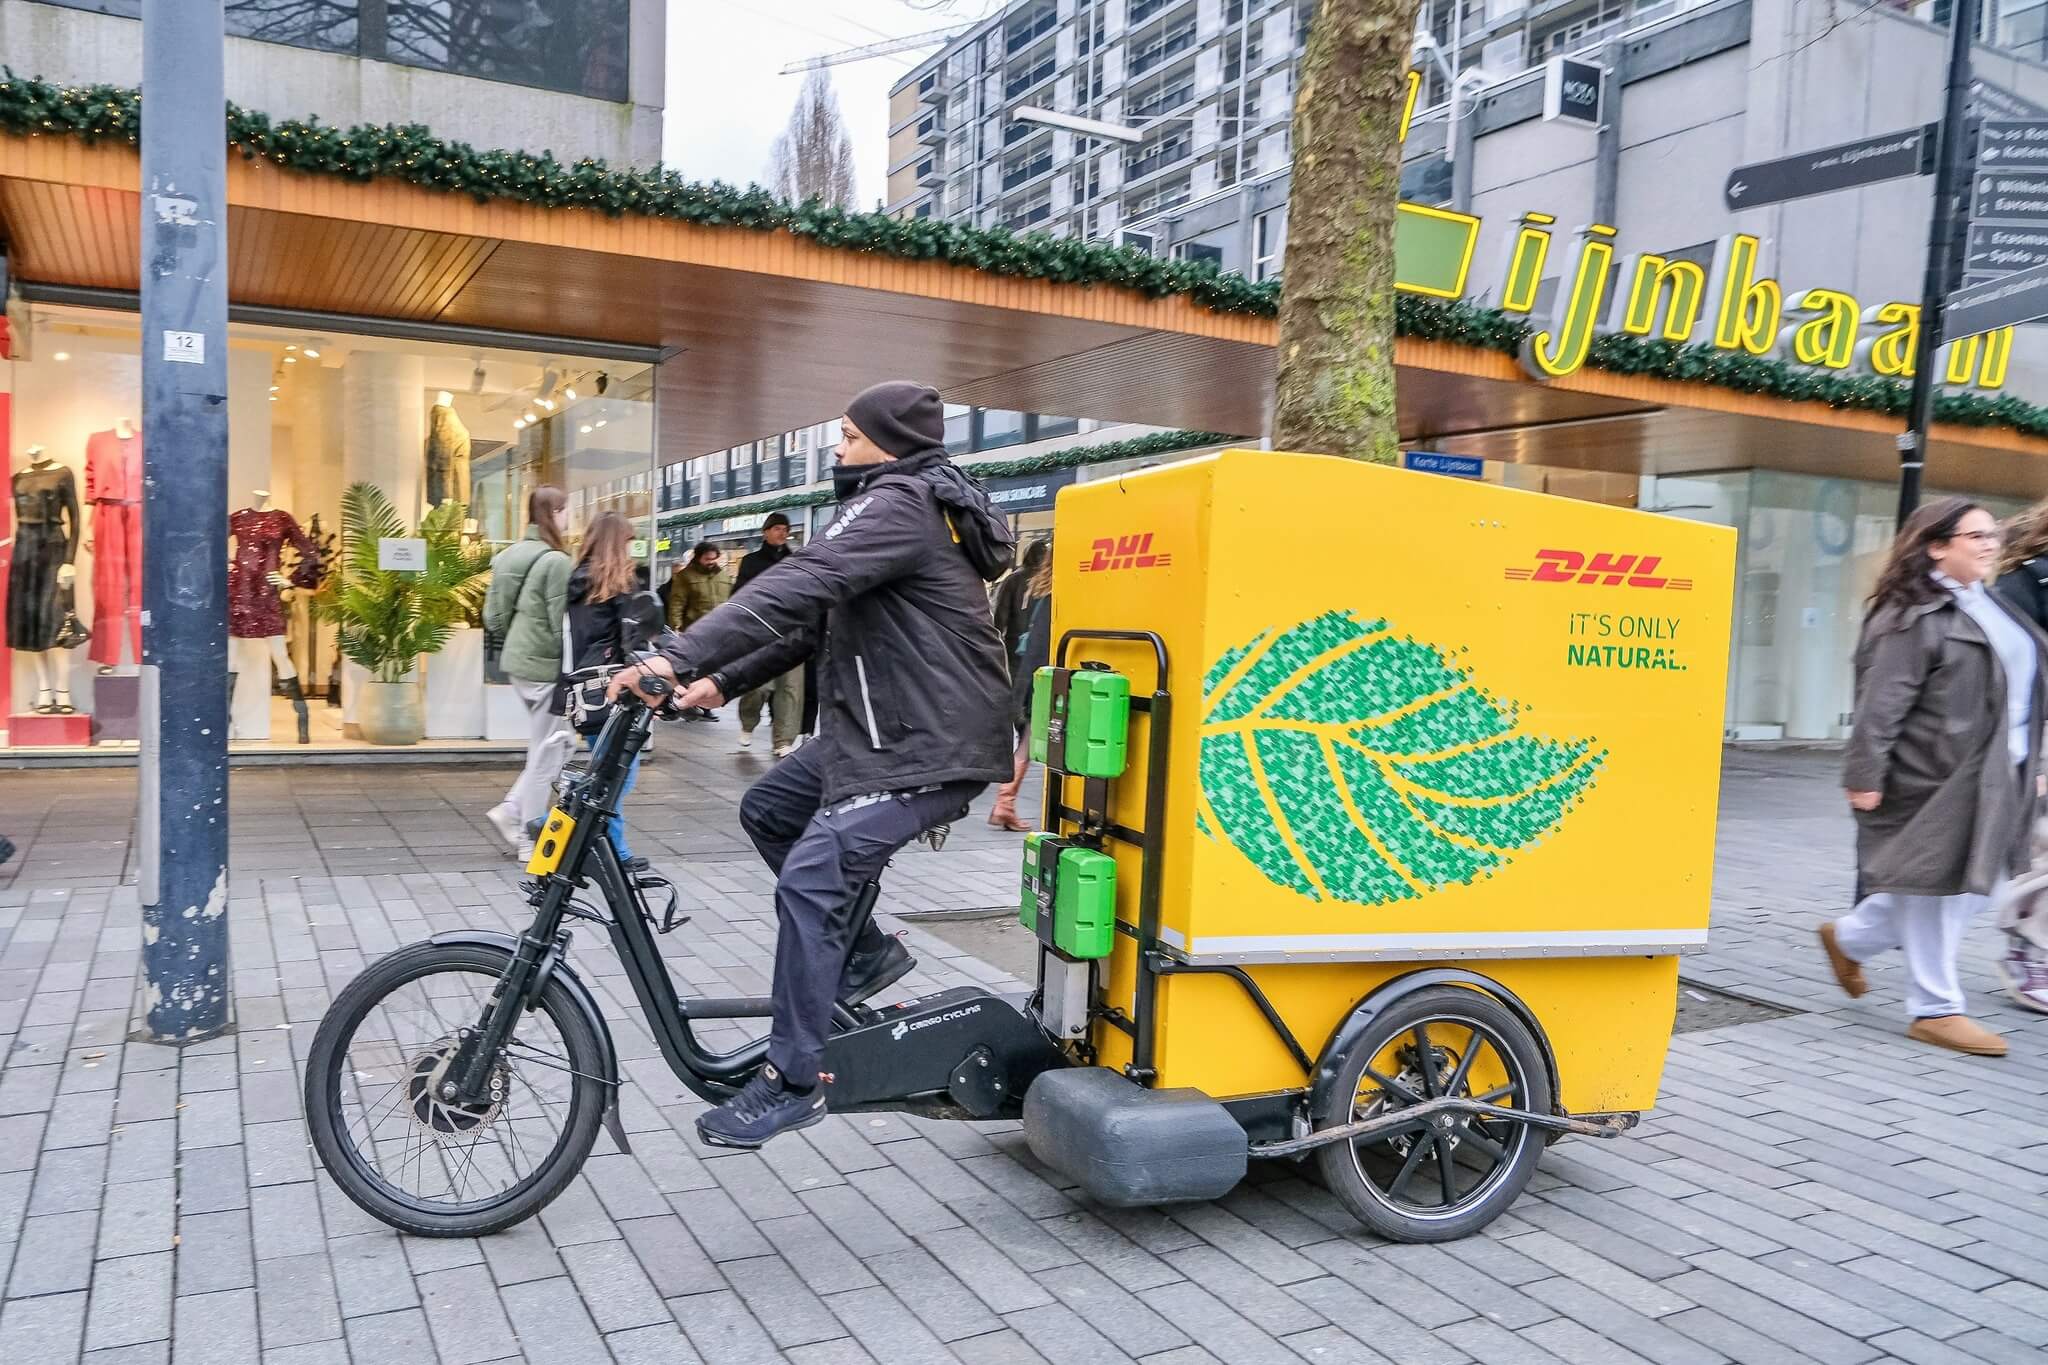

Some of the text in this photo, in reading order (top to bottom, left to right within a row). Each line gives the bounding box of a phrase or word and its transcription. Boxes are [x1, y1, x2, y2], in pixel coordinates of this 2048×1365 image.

[176, 335, 193, 348] 12
[1412, 455, 1476, 473] Korte Lijnbaan
[825, 498, 872, 539] DHL
[1088, 532, 1160, 572] DHL
[1529, 547, 1670, 589] DHL
[1618, 615, 1682, 640] ONLY
[1566, 644, 1688, 671] NATURAL.
[909, 1004, 982, 1031] CARGO CYCLING
